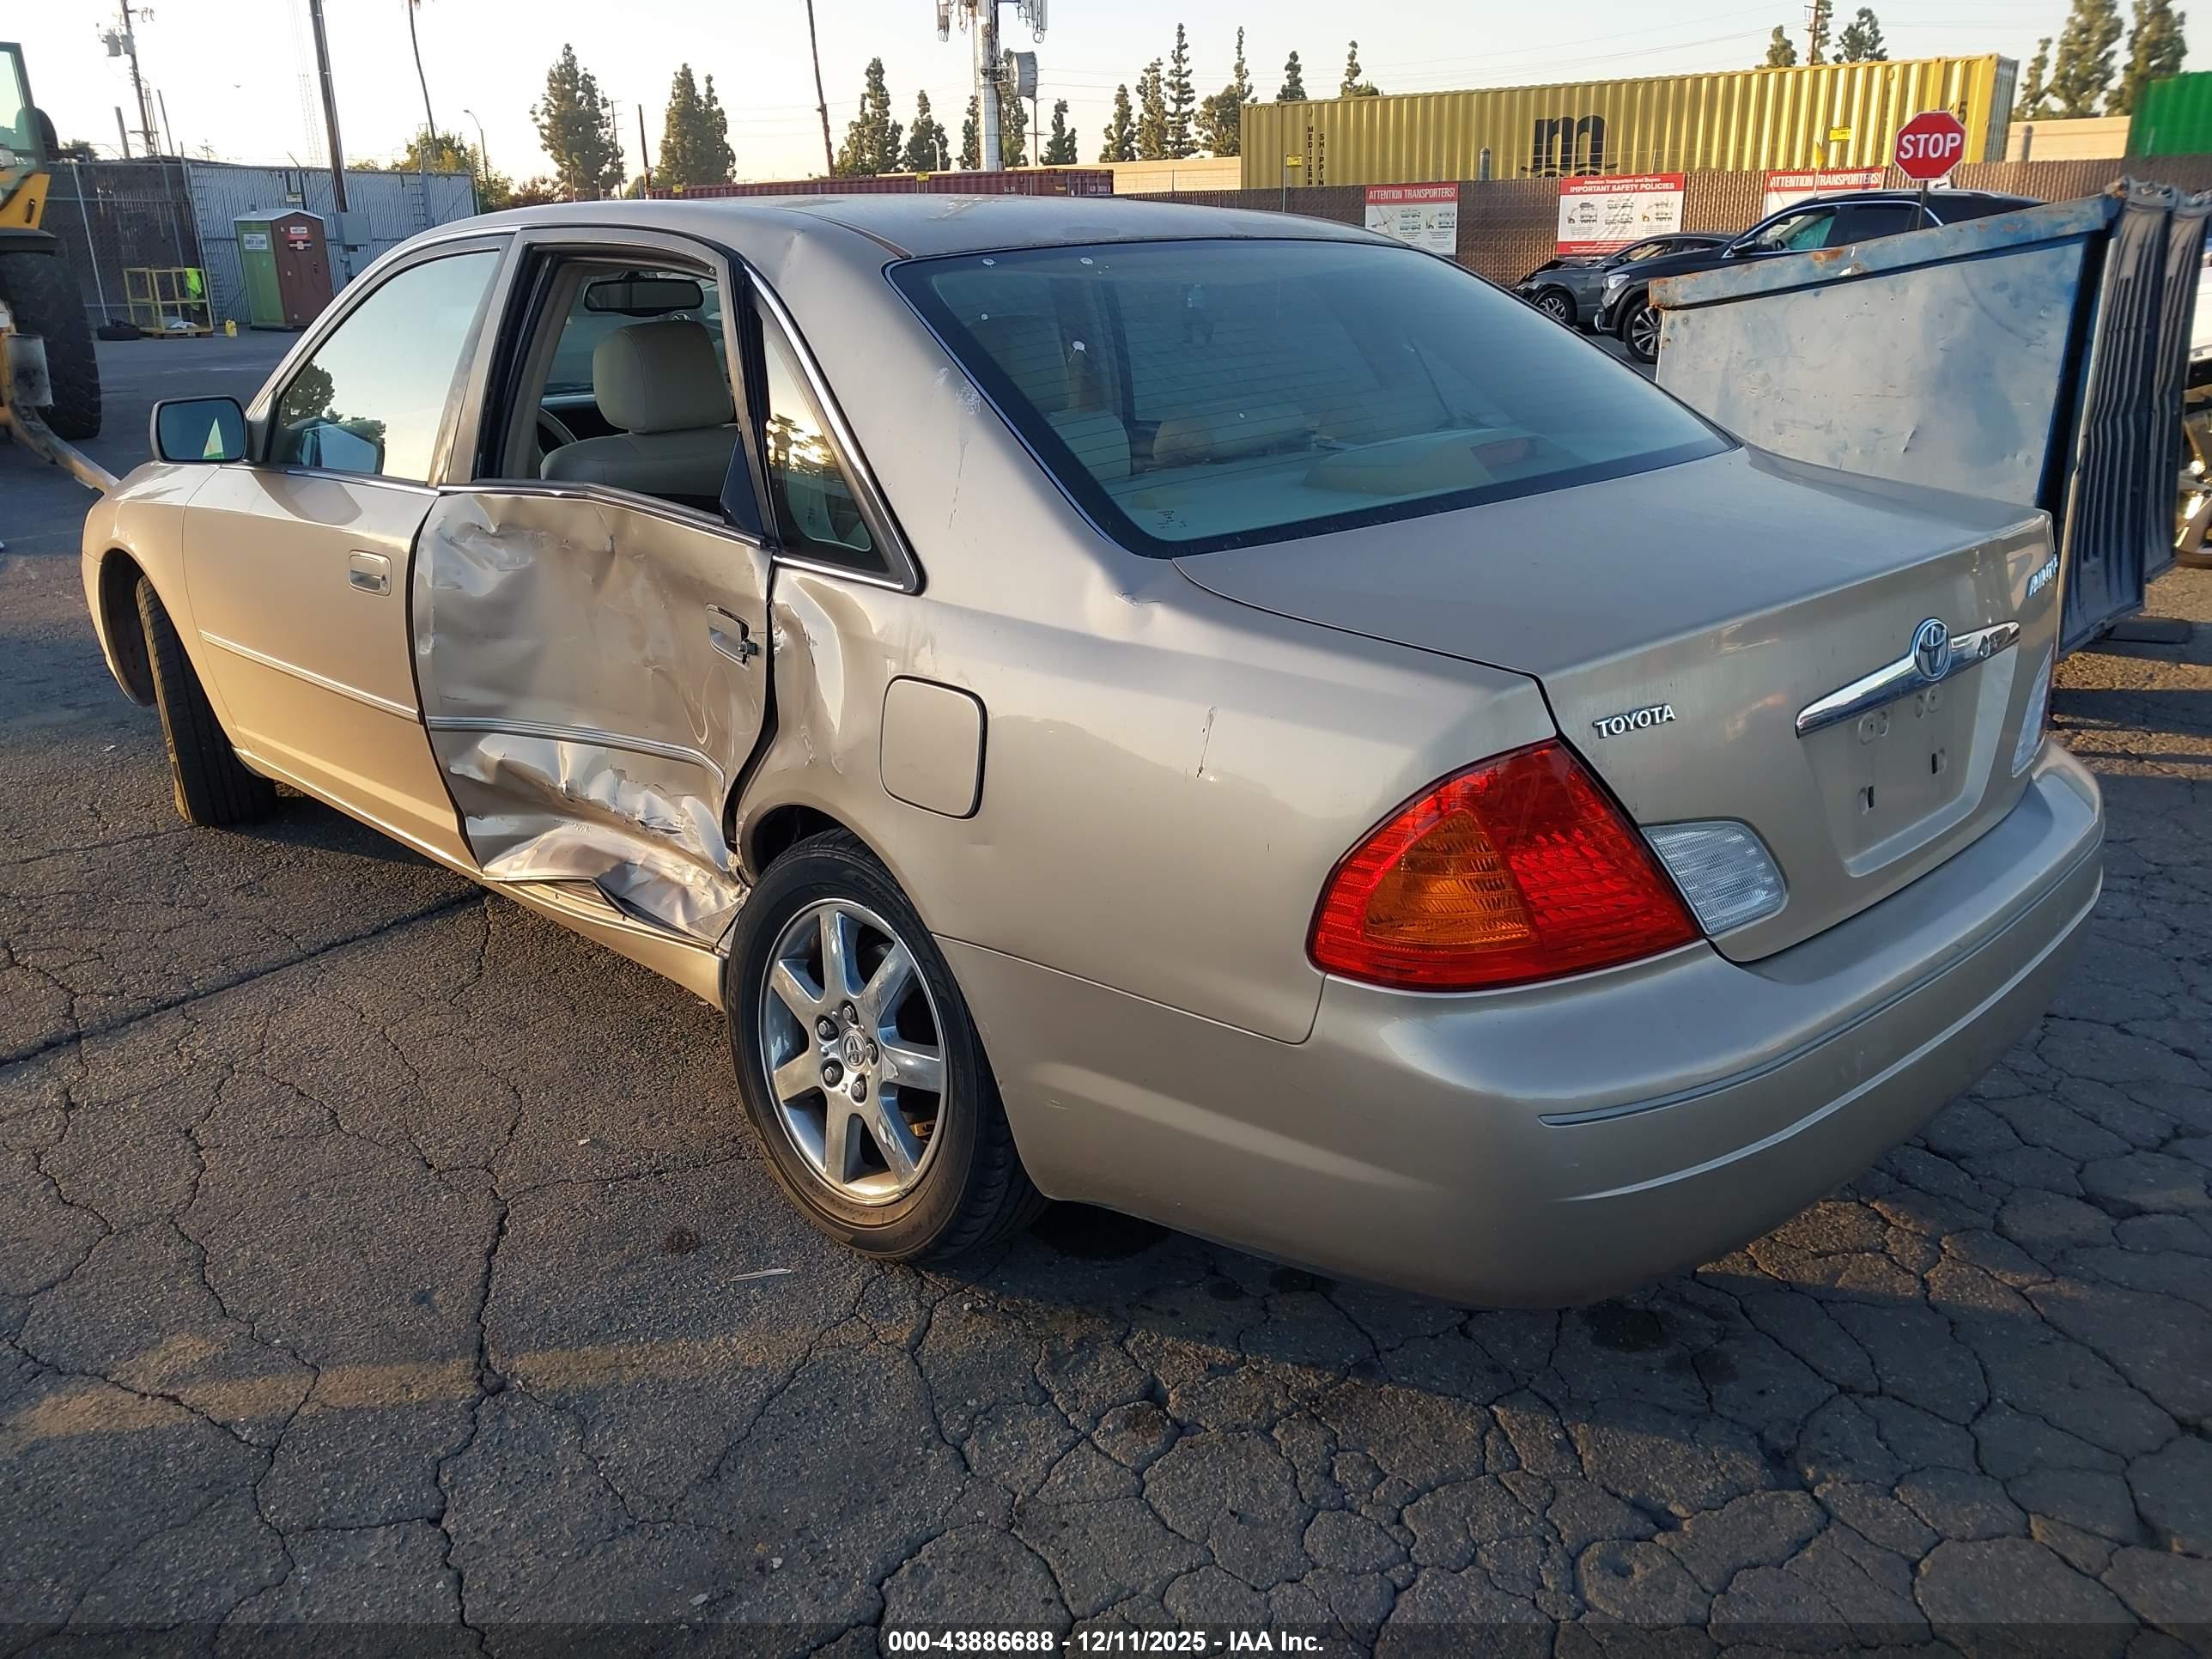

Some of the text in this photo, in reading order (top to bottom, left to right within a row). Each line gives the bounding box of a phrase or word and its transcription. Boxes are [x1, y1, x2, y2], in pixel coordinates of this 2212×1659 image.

[1899, 132, 1961, 160] STOP
[1570, 182, 1675, 193] IMPORTANT SAFETY POLICIES
[1771, 172, 1881, 188] ATTENTION TRANSPORTERS!
[1369, 187, 1455, 200] ATTENTION TRANSPORTERS!
[1592, 703, 1676, 739] TOYOTA
